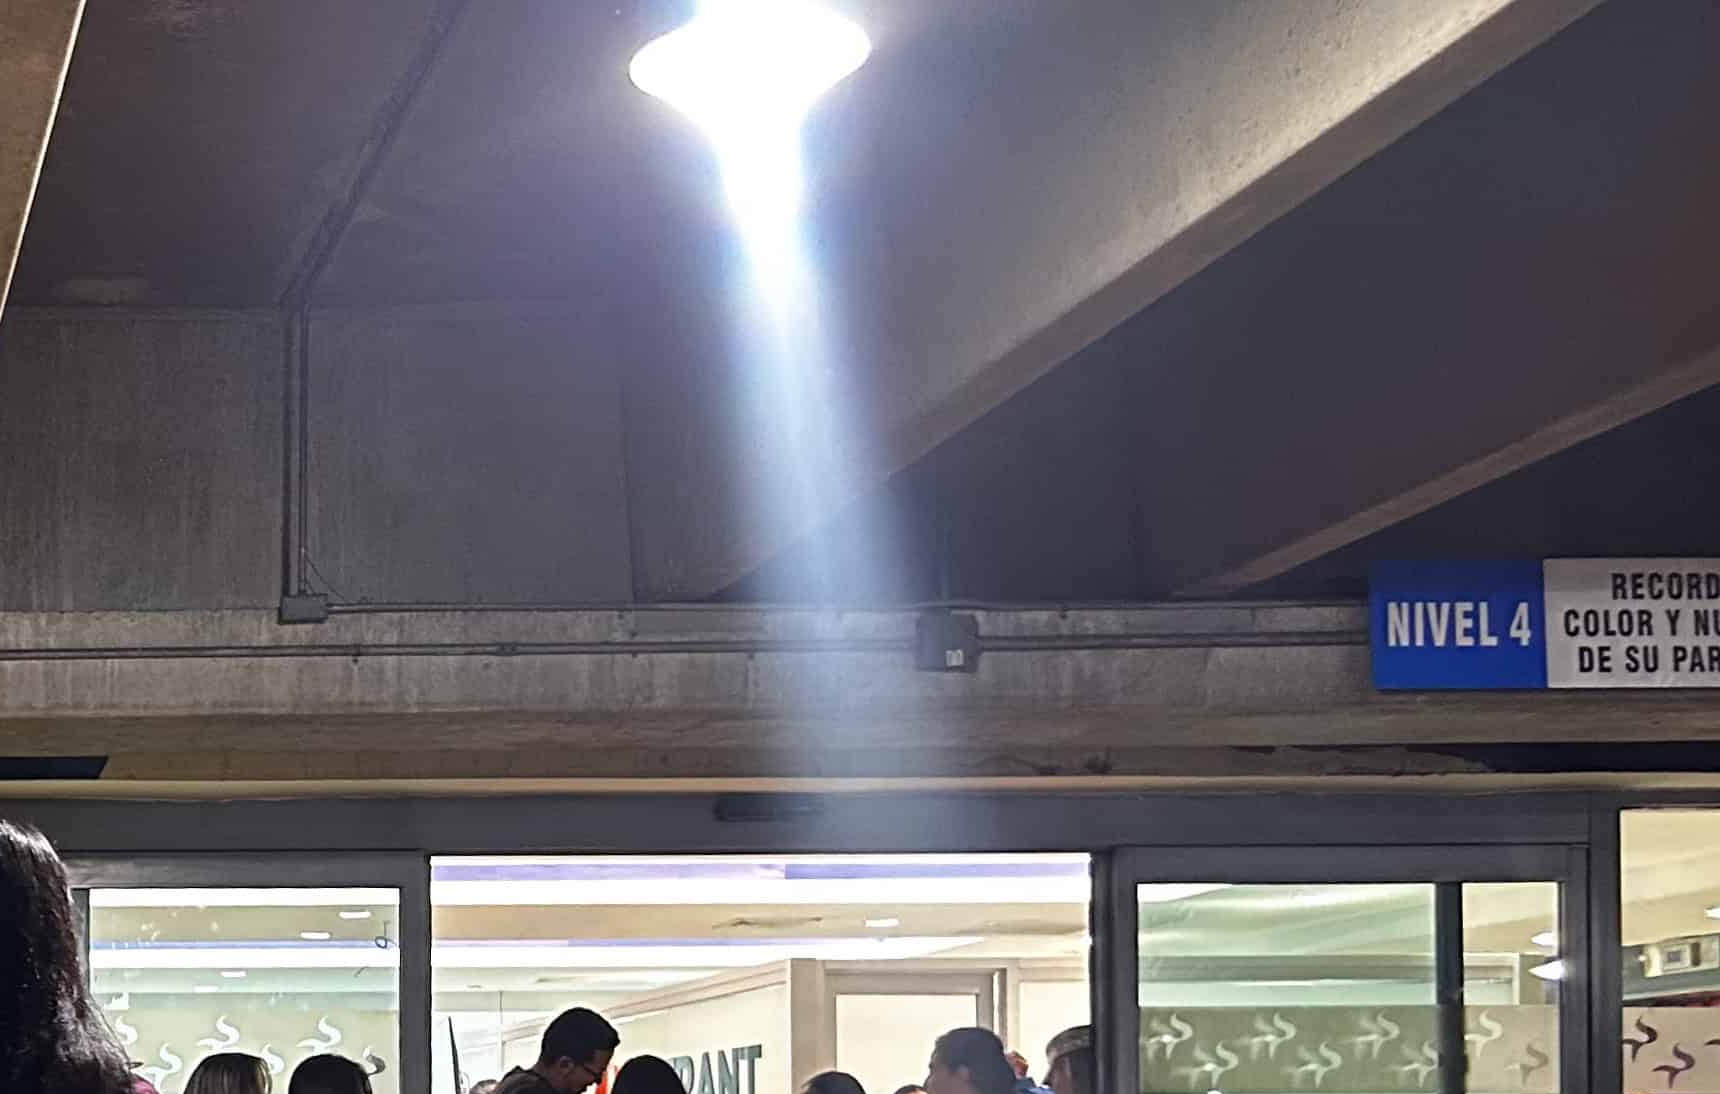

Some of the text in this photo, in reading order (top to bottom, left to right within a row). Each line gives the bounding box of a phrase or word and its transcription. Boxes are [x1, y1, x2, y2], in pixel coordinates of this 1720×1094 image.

[1612, 573, 1720, 600] RECORD
[1387, 602, 1531, 647] NIVEL 4
[1564, 610, 1654, 637] COLOR
[1665, 610, 1681, 636] Y
[1580, 645, 1720, 673] DE SU PAR
